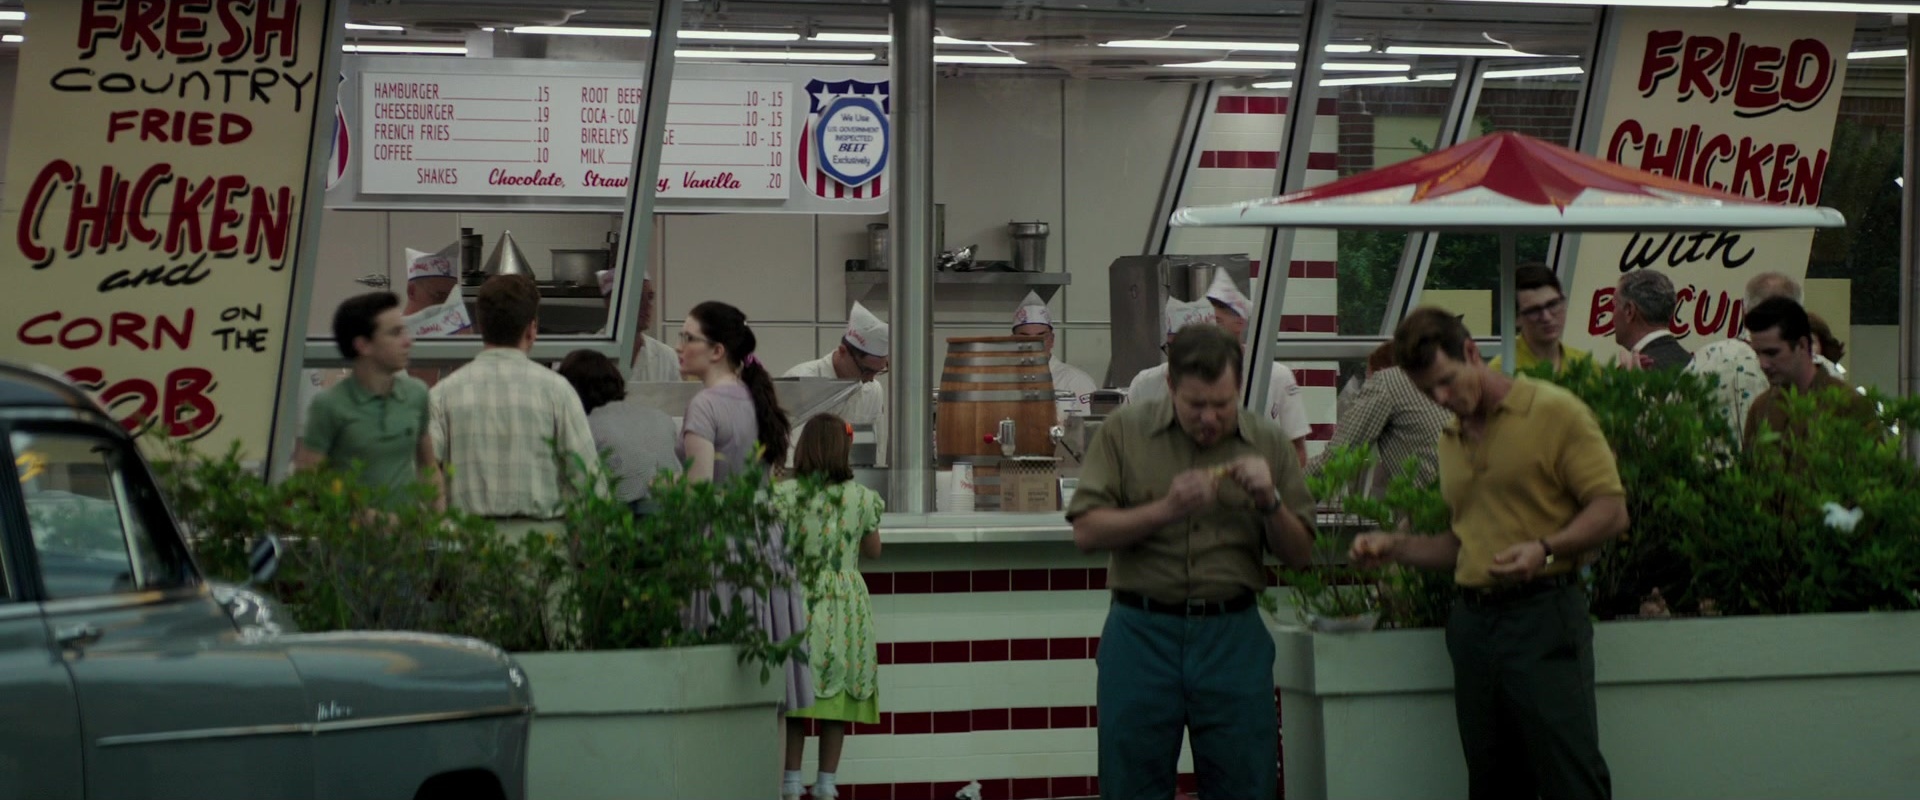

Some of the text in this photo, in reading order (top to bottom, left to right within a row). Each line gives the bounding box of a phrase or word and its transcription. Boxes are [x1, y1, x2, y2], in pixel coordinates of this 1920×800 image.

[77, 0, 301, 67] FRESH
[1637, 30, 1836, 118] FRIED
[374, 82, 550, 102] HAMBURGER .15
[581, 86, 608, 103] ROOT
[617, 88, 643, 104] BEER
[743, 90, 758, 106] .10
[768, 91, 783, 107] .15
[374, 103, 550, 122] CHEESEBURGER .19
[742, 111, 758, 126] .10
[767, 111, 783, 127] .15
[841, 113, 870, 122] We Use
[107, 108, 253, 146] FRIED
[374, 123, 549, 143] FRENCH FRIES .10
[581, 127, 629, 144] BIRELEYS
[742, 131, 757, 146] .10
[767, 131, 782, 147] .15
[835, 134, 873, 142] INSPECTED
[839, 143, 868, 152] BEEF
[374, 144, 549, 163] COFFEE .10
[580, 148, 782, 167] MILK .10
[832, 154, 870, 167] Exclusively
[417, 168, 458, 185] SHAKES
[682, 170, 742, 189] Vanilla
[766, 173, 782, 188] .20
[17, 159, 294, 270] CHICKEN
[1618, 231, 1755, 272] With
[97, 253, 212, 292] and
[220, 303, 262, 322] ON
[17, 307, 195, 350] CORN
[211, 327, 269, 352] THE
